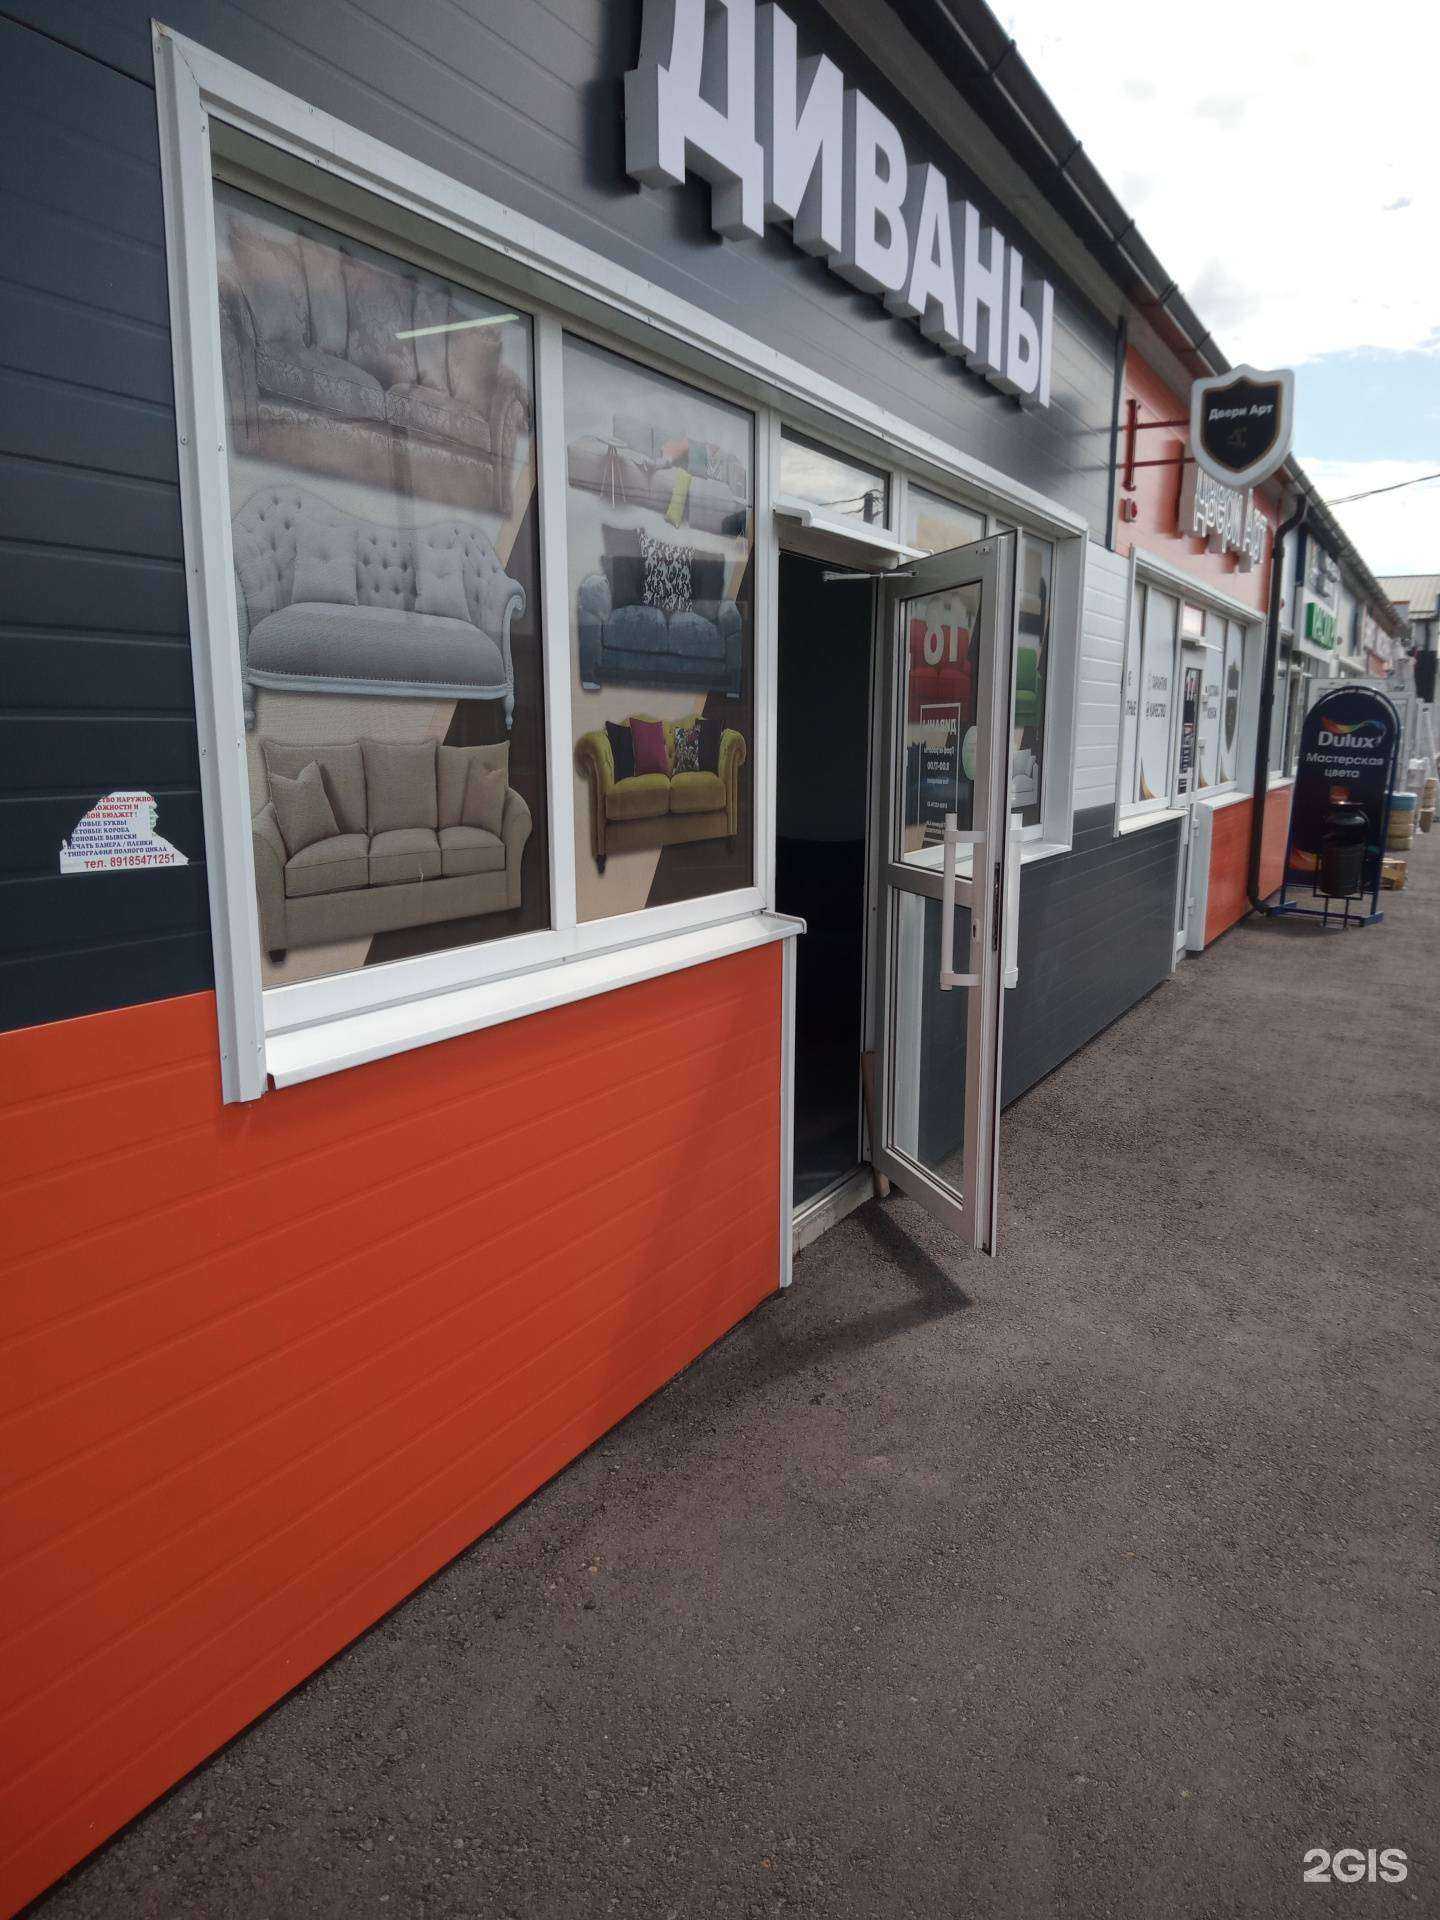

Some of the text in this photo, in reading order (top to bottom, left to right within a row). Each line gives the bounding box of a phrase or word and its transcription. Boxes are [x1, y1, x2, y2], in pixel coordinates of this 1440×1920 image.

[640, 0, 1055, 409] ДИВАНЫ
[1207, 404, 1274, 421] Двери Арт
[1317, 730, 1374, 748] Dulux
[1305, 752, 1384, 766] Мастерская
[1324, 768, 1360, 778] цвета
[110, 853, 176, 868] 89185471251
